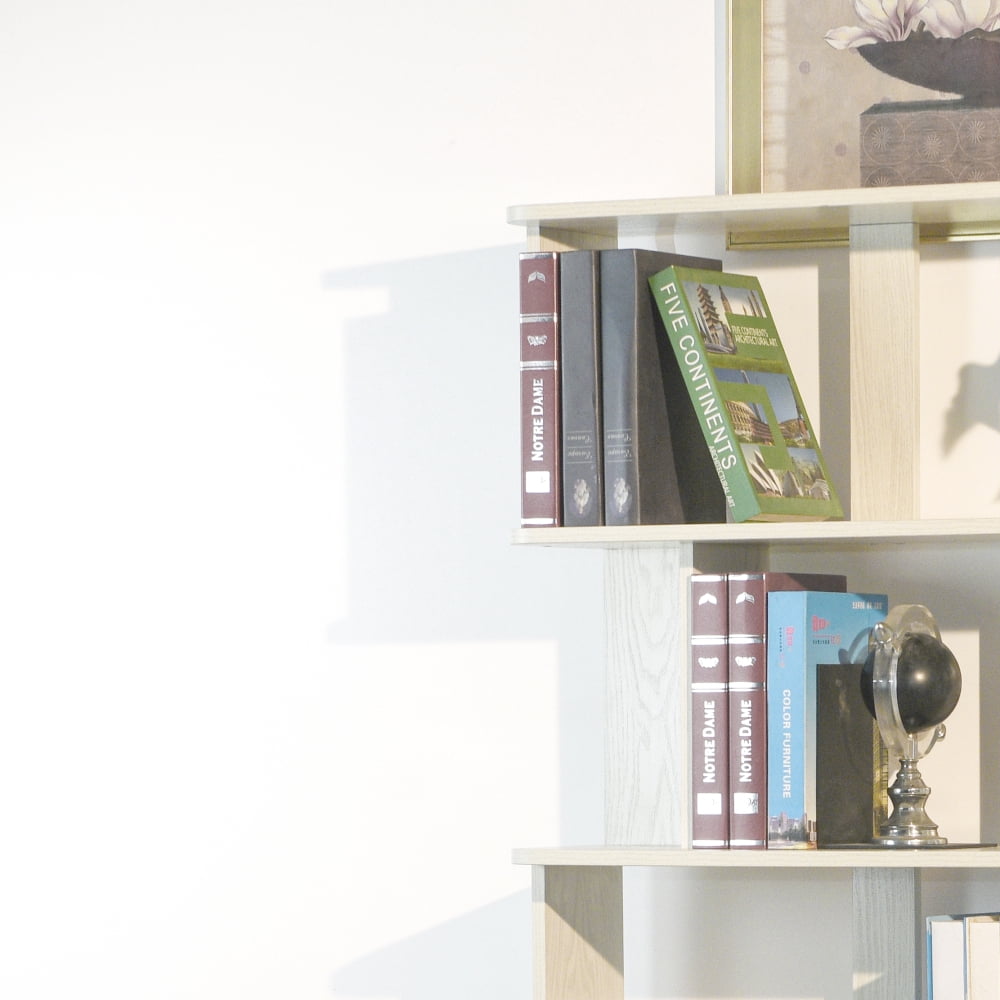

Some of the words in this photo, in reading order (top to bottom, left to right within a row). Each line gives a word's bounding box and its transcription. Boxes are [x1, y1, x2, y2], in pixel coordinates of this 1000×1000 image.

[531, 378, 544, 416] DAME
[660, 282, 688, 333] FIVE
[679, 335, 737, 470] CONTINENTS
[531, 417, 544, 462] NOTRE
[709, 445, 731, 497] ARCHITECTURAL
[726, 494, 736, 508] ART
[702, 700, 716, 738] DAME
[739, 699, 752, 737] DAME
[782, 689, 791, 729] COLOR
[702, 739, 716, 783] NOTRE
[739, 738, 752, 782] NOTRE
[783, 732, 792, 799] FURNITURE
